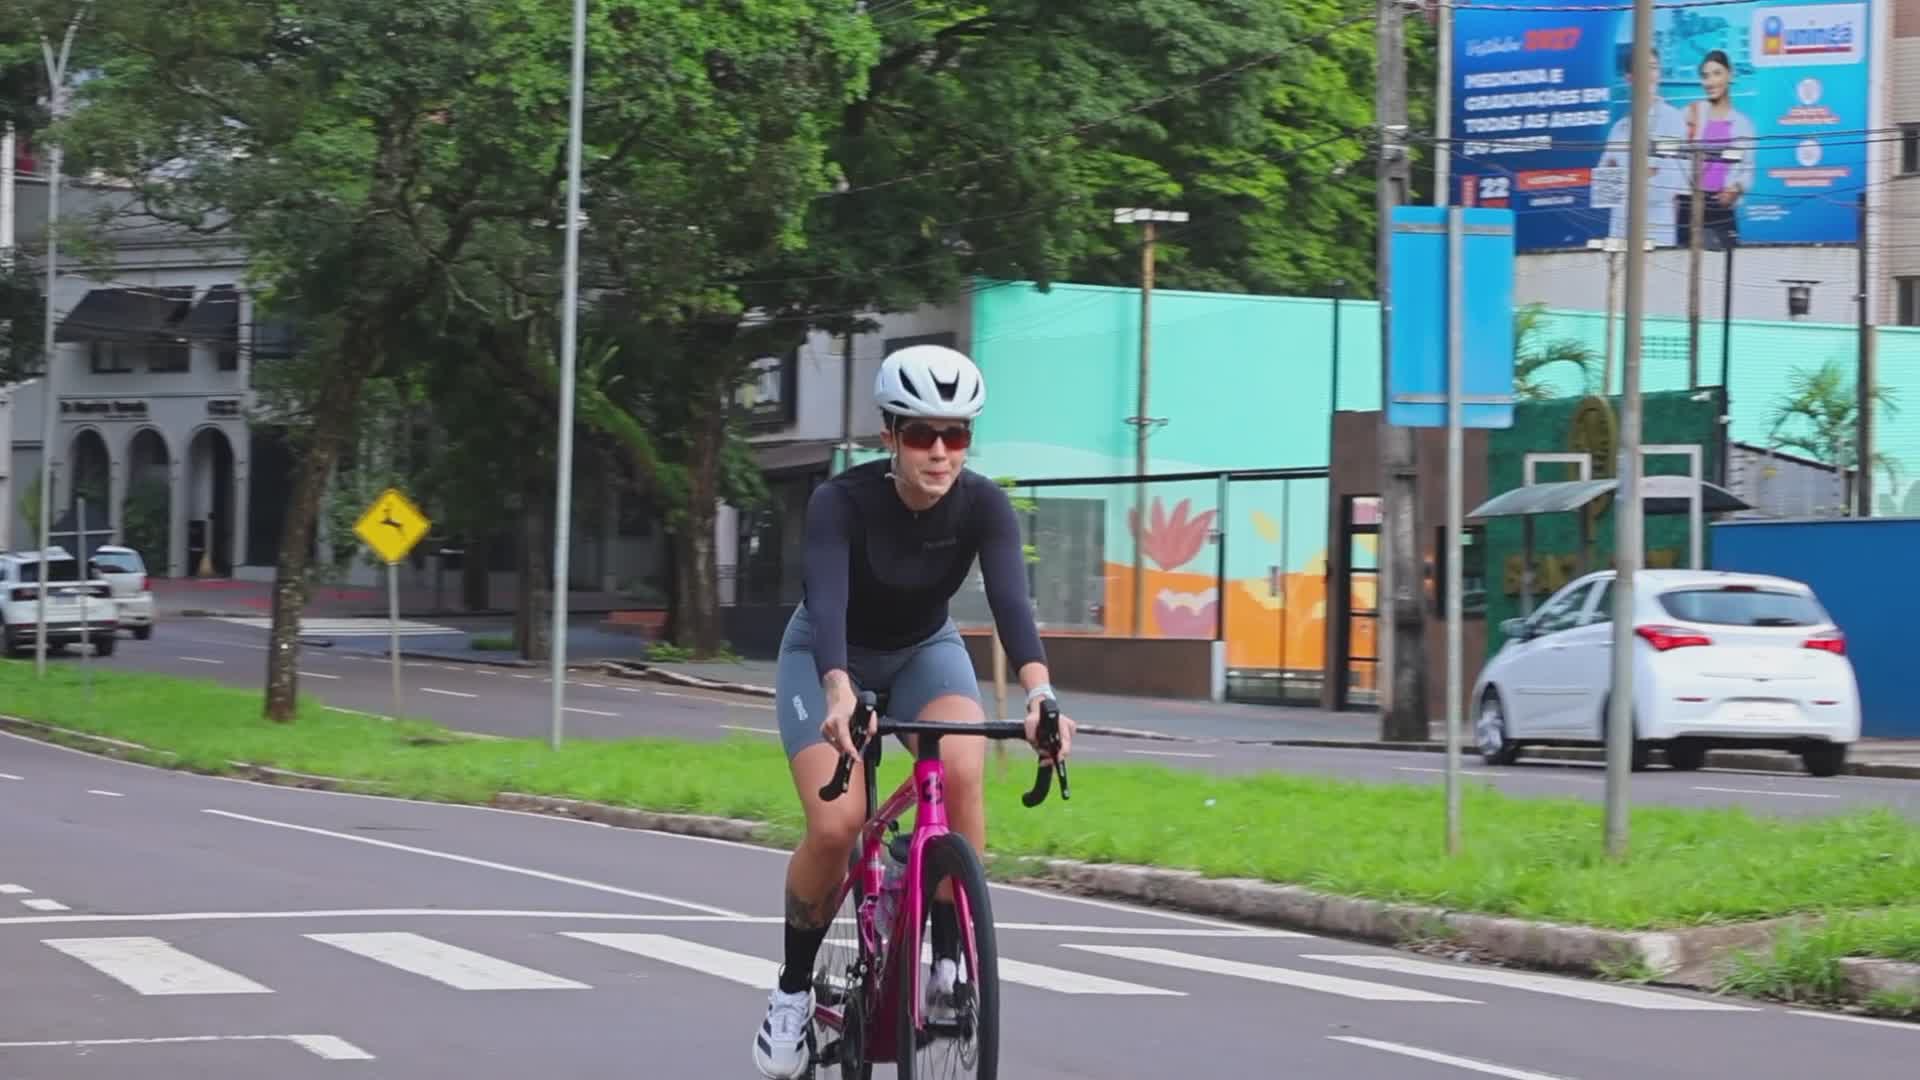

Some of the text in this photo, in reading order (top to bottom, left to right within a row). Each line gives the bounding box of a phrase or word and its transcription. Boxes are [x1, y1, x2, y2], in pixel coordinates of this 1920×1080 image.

[1464, 68, 1564, 89] MEDICINA E
[1464, 87, 1611, 111] GRADUAÇÕES EM
[1464, 115, 1522, 133] TODAS
[1523, 113, 1549, 129] AS
[1480, 176, 1510, 198] 22
